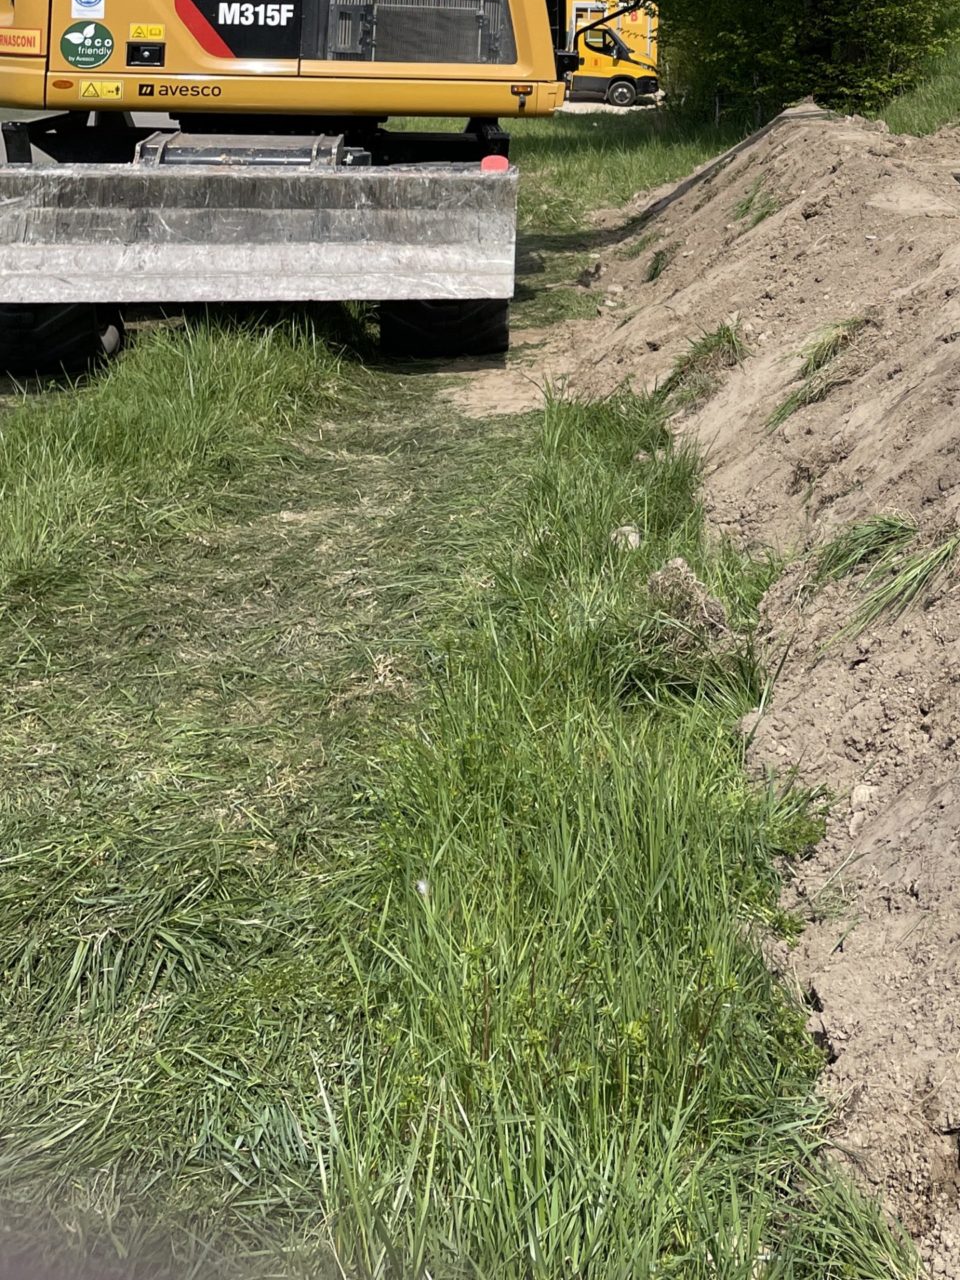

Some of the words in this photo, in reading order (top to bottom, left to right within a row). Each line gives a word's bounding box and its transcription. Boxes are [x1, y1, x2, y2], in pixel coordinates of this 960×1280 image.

[218, 2, 294, 26] M315F
[84, 38, 112, 47] eco
[78, 46, 112, 56] friendly
[158, 84, 222, 97] avesco
